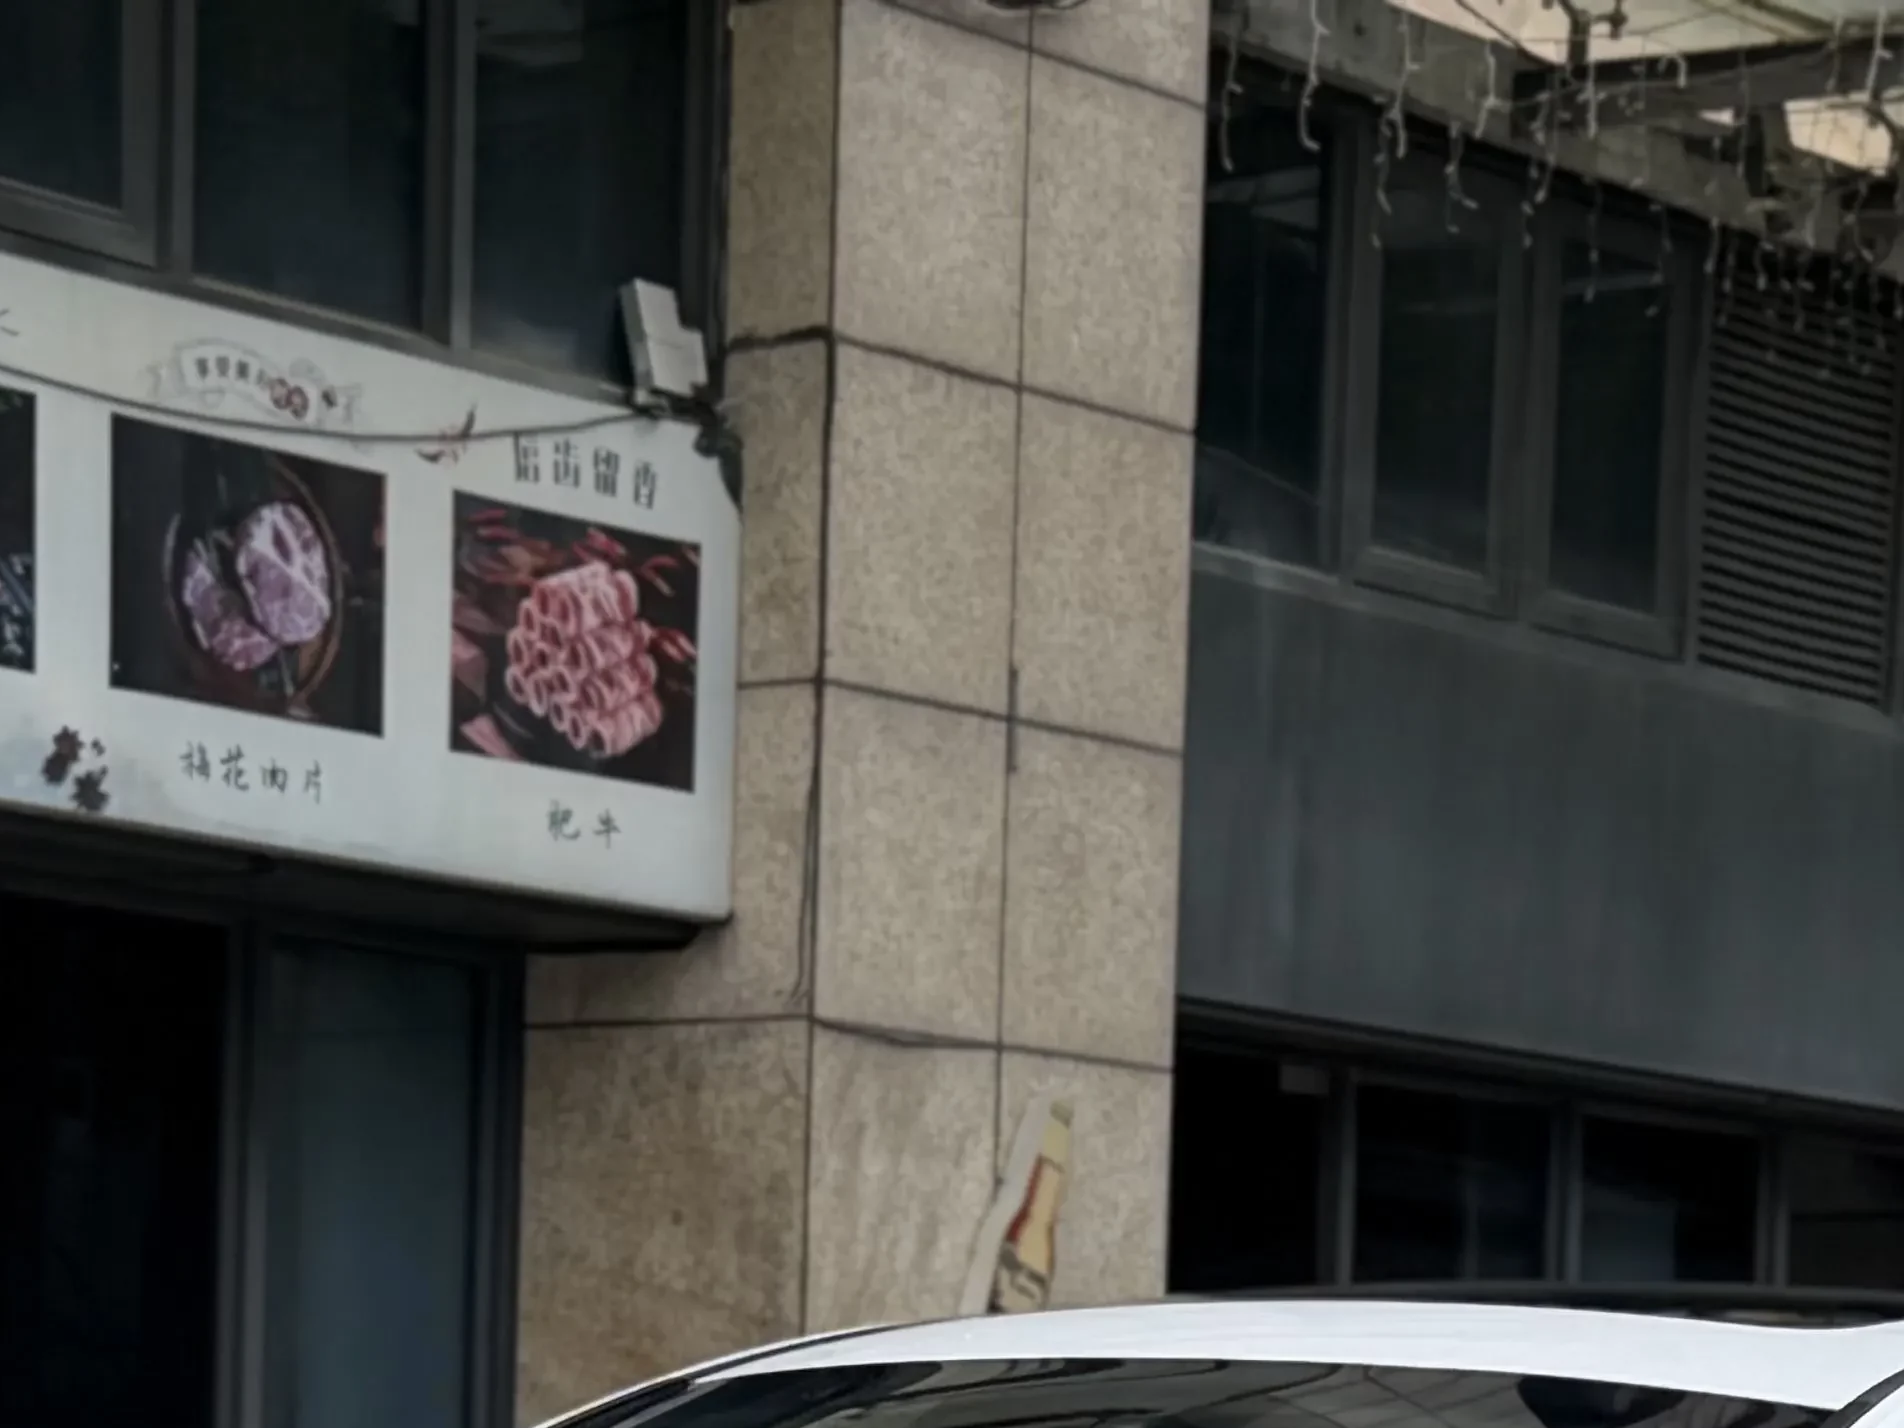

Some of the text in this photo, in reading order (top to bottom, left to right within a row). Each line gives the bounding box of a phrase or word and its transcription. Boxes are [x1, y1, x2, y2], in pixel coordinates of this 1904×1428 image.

[179, 741, 322, 805] 梅花肉片
[547, 799, 622, 850] 肥牛
